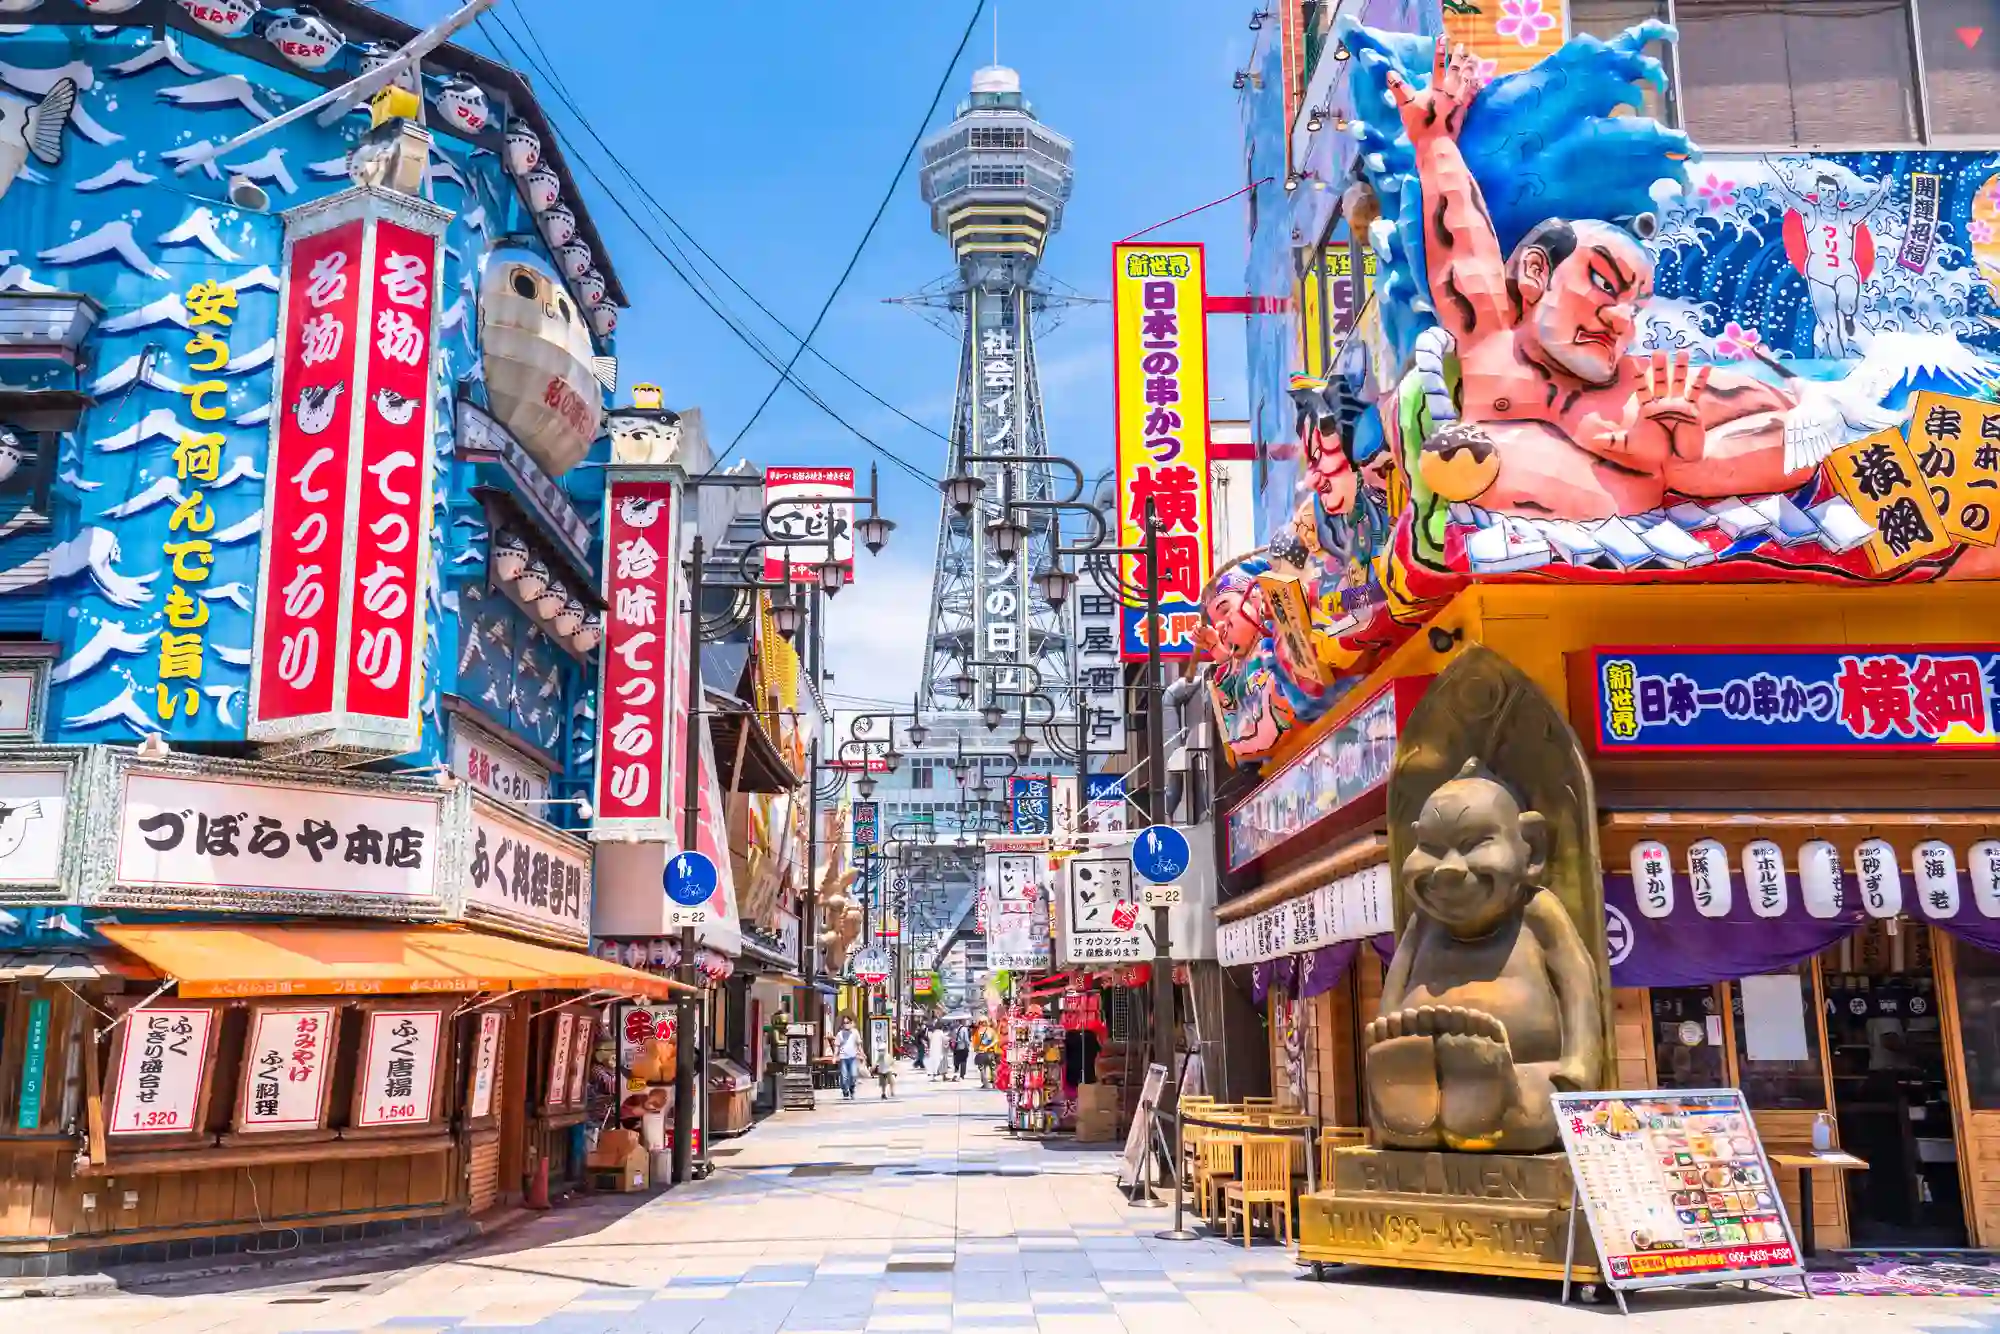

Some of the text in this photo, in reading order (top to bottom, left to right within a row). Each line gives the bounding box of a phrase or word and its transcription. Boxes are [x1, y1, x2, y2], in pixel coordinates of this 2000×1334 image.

[1128, 255, 1190, 277] 新世界
[1143, 281, 1182, 462] 日本一の串かつ
[1917, 405, 1961, 516] 串かつ
[157, 280, 237, 720] 安うて何んでも旨い
[278, 447, 335, 690] てっちり
[356, 450, 417, 690] てっちり
[609, 537, 659, 807] 珍味てっちり
[1608, 665, 1637, 737] 新世界
[1639, 674, 1837, 724] 日本一の串かつ
[1838, 657, 1986, 736] 横綱
[138, 808, 424, 869] づぼらや本店
[470, 827, 581, 920] ふぐ料理専門
[1645, 861, 1666, 908] 串かつ
[1692, 856, 1712, 907] 豚バラ
[1757, 858, 1779, 909] ホルモン
[1862, 858, 1884, 908] 砂ずり
[1925, 859, 1950, 910] 海老
[136, 1015, 192, 1103] ふぐ にぎり盛合せ
[254, 1050, 284, 1116] ふぐ料理
[288, 1016, 319, 1081] おみやげ
[378, 1104, 415, 1119] 1,540
